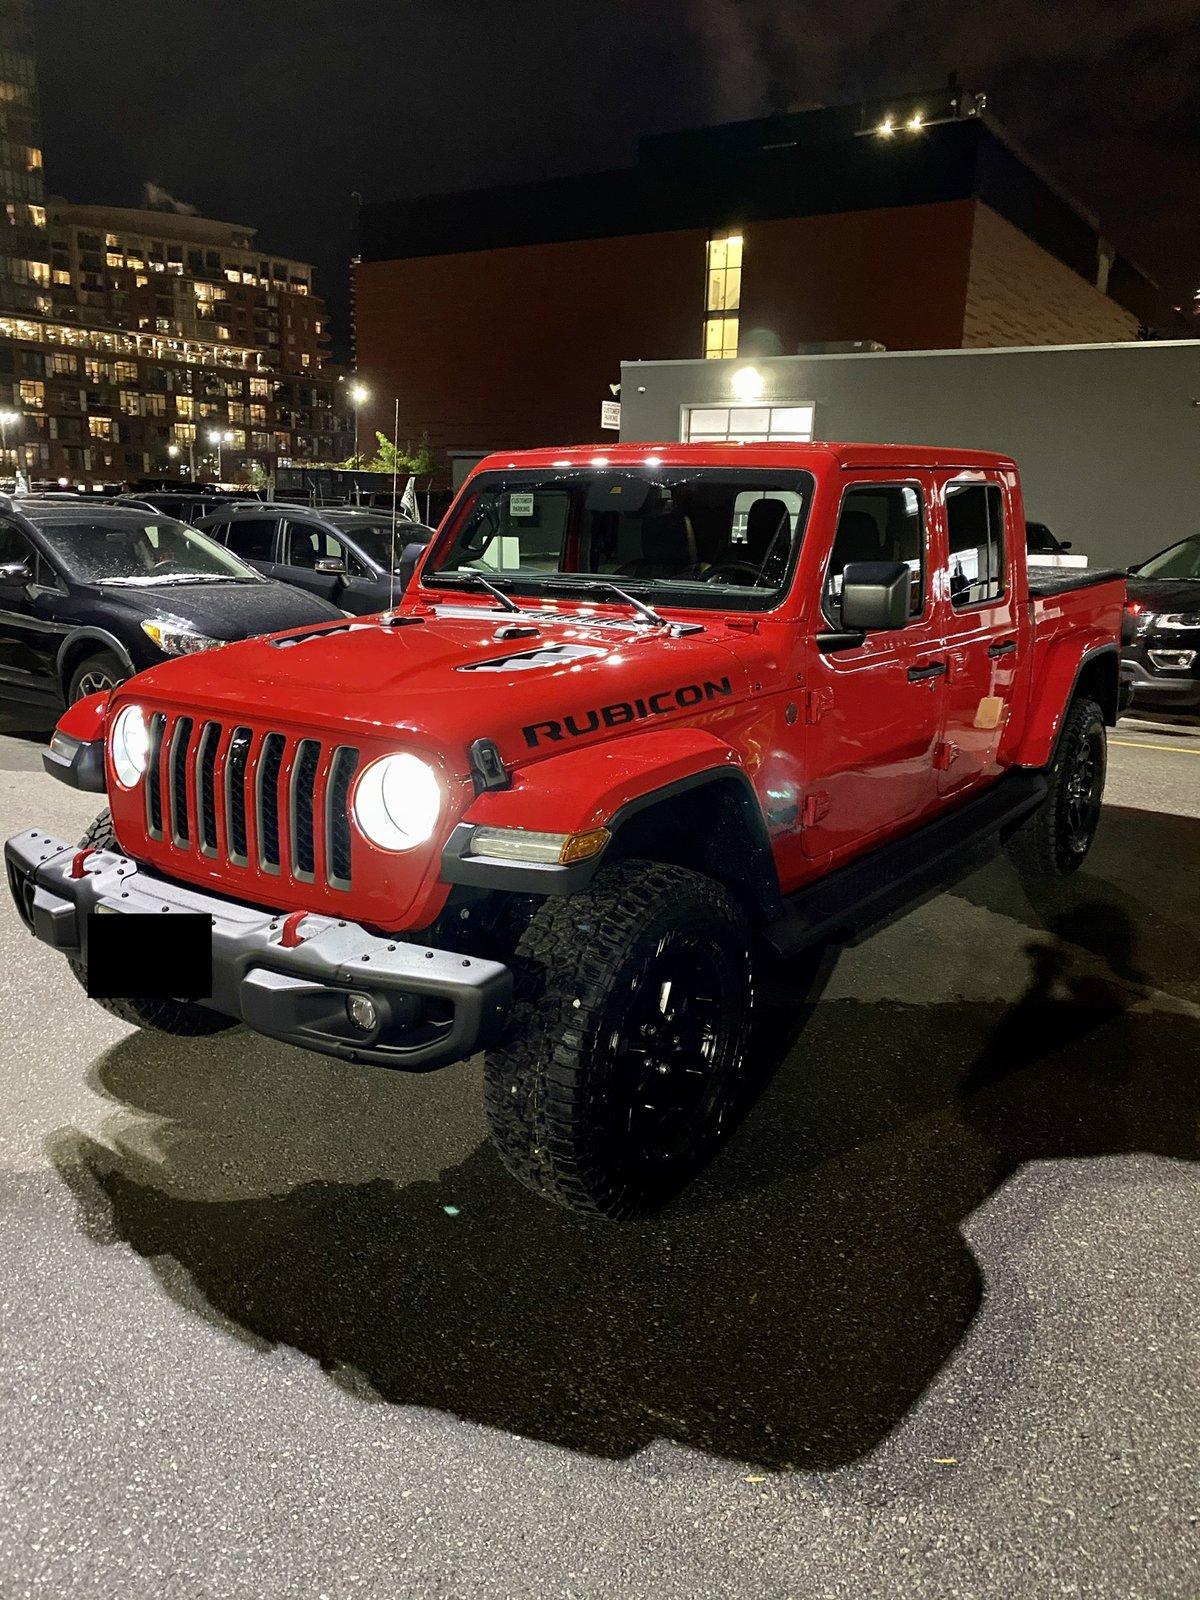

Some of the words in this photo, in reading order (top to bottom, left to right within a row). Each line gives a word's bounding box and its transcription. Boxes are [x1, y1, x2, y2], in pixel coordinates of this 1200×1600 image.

[603, 407, 620, 415] CUSTOMER
[512, 505, 530, 513] PARKING
[521, 676, 733, 747] RUBICON
